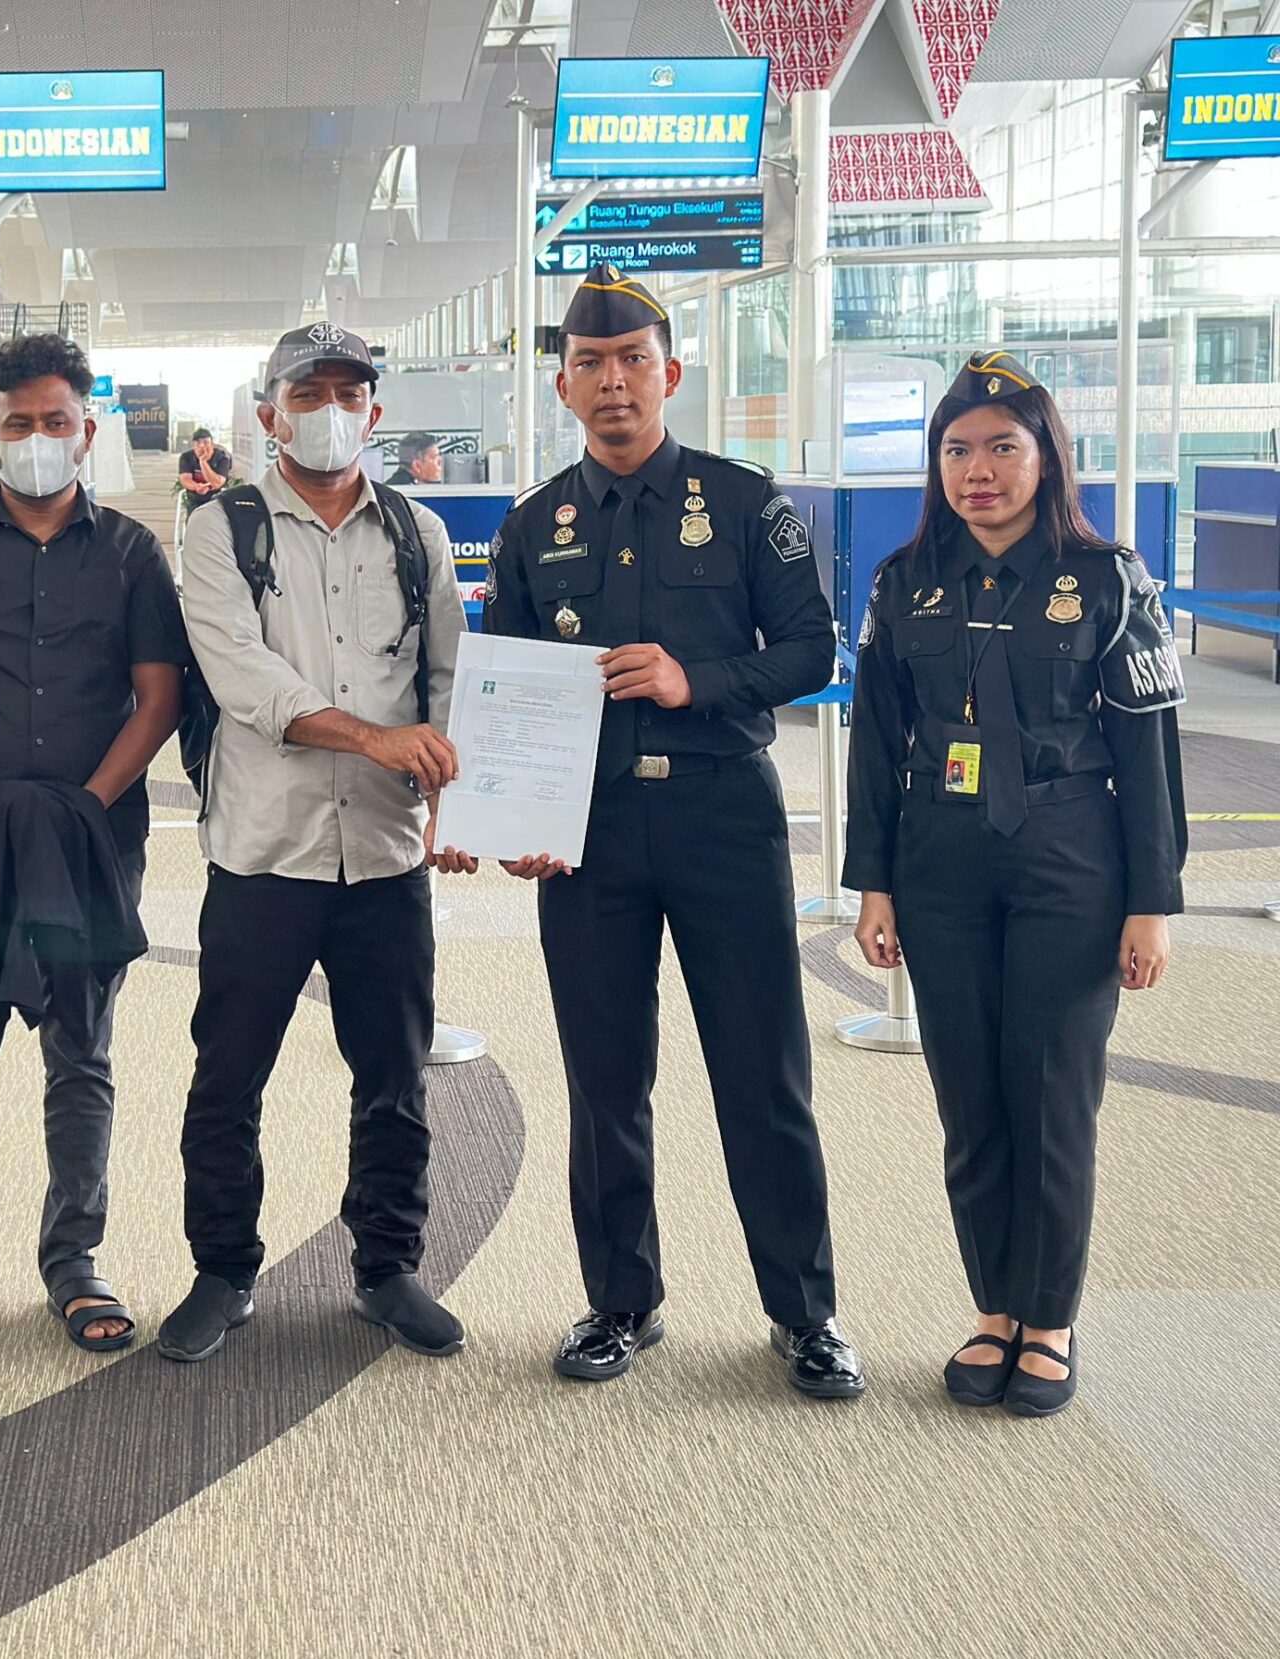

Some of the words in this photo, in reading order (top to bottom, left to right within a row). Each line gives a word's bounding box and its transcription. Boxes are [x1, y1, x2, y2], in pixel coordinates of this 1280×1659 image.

[567, 114, 749, 144] INDONESIAN
[589, 204, 626, 219] Ruang
[629, 202, 670, 218] Tunggu
[673, 200, 724, 215] Eksekutif
[589, 243, 635, 260] Ruang
[638, 241, 697, 256] Merokok
[293, 344, 331, 358] PHILIPP
[127, 406, 166, 424] aphire
